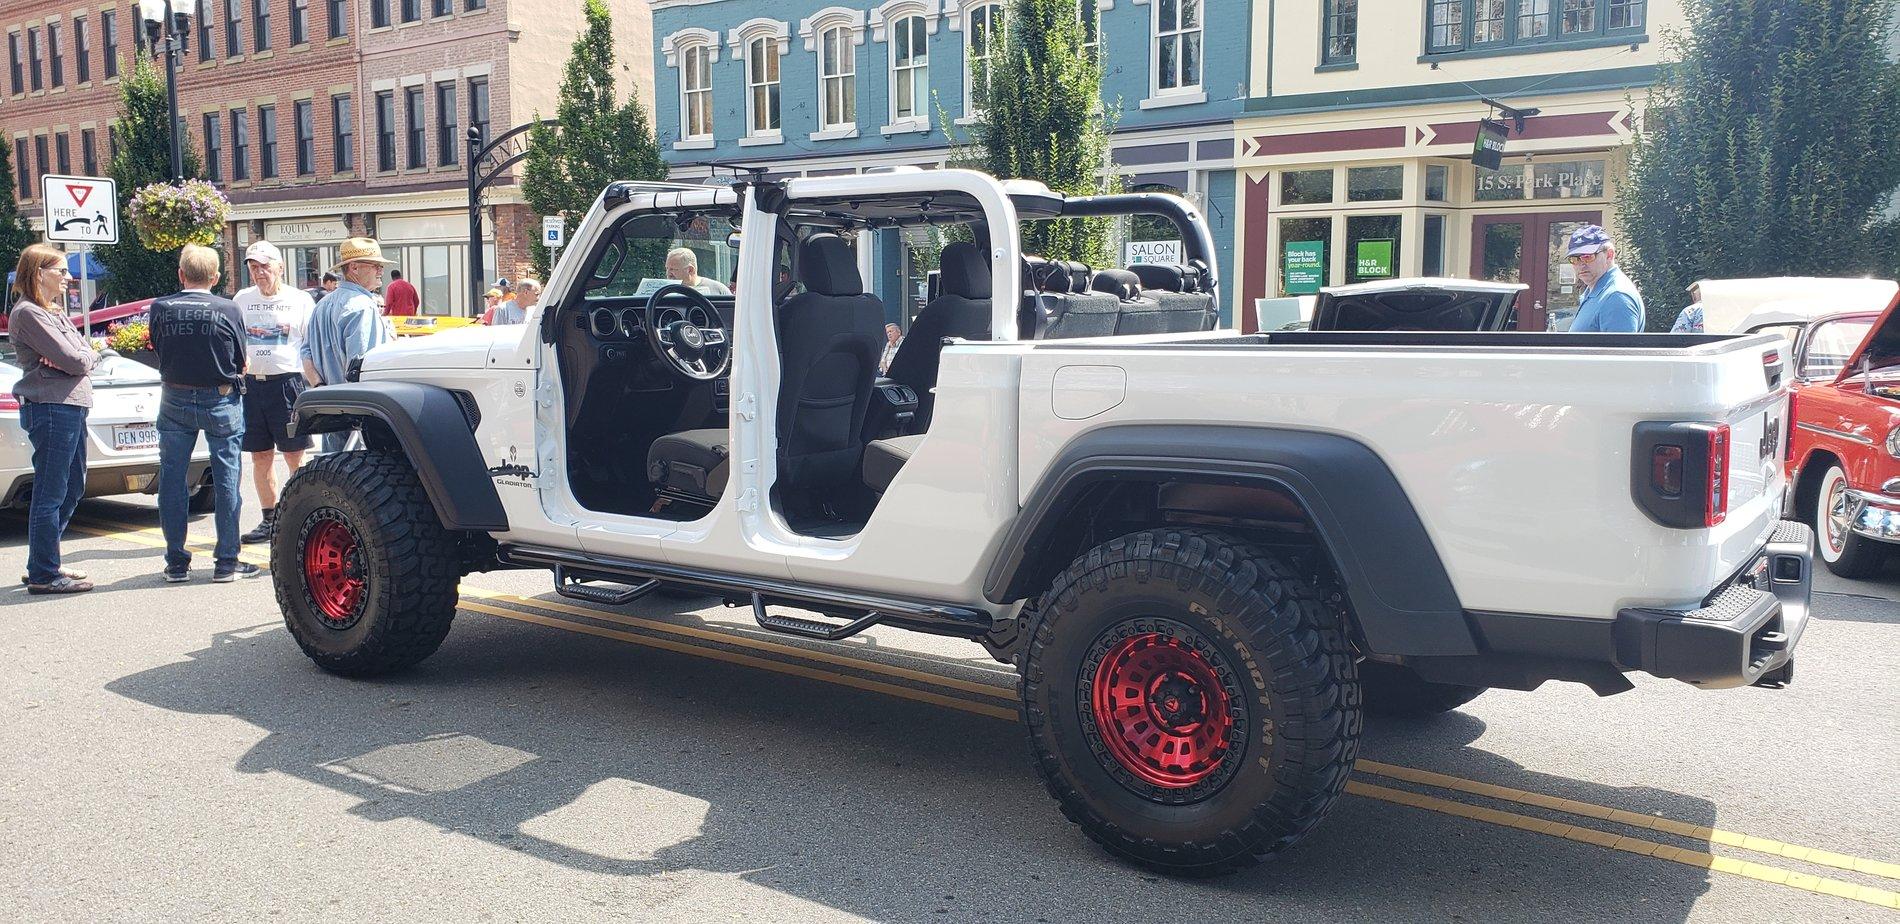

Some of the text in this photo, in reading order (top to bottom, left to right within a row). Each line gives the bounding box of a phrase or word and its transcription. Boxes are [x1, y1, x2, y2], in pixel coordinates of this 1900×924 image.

[1478, 175, 1494, 191] 15
[1497, 175, 1511, 190] S.
[53, 207, 78, 218] HERE
[81, 226, 92, 235] TO
[280, 223, 311, 235] EQUITY
[1131, 244, 1176, 256] SALON
[1143, 255, 1175, 264] SQUARE
[1359, 259, 1377, 267] H&R
[117, 431, 137, 446] GEN
[496, 478, 532, 488] GLADIATOR
[1189, 601, 1272, 711] PATRIOT
